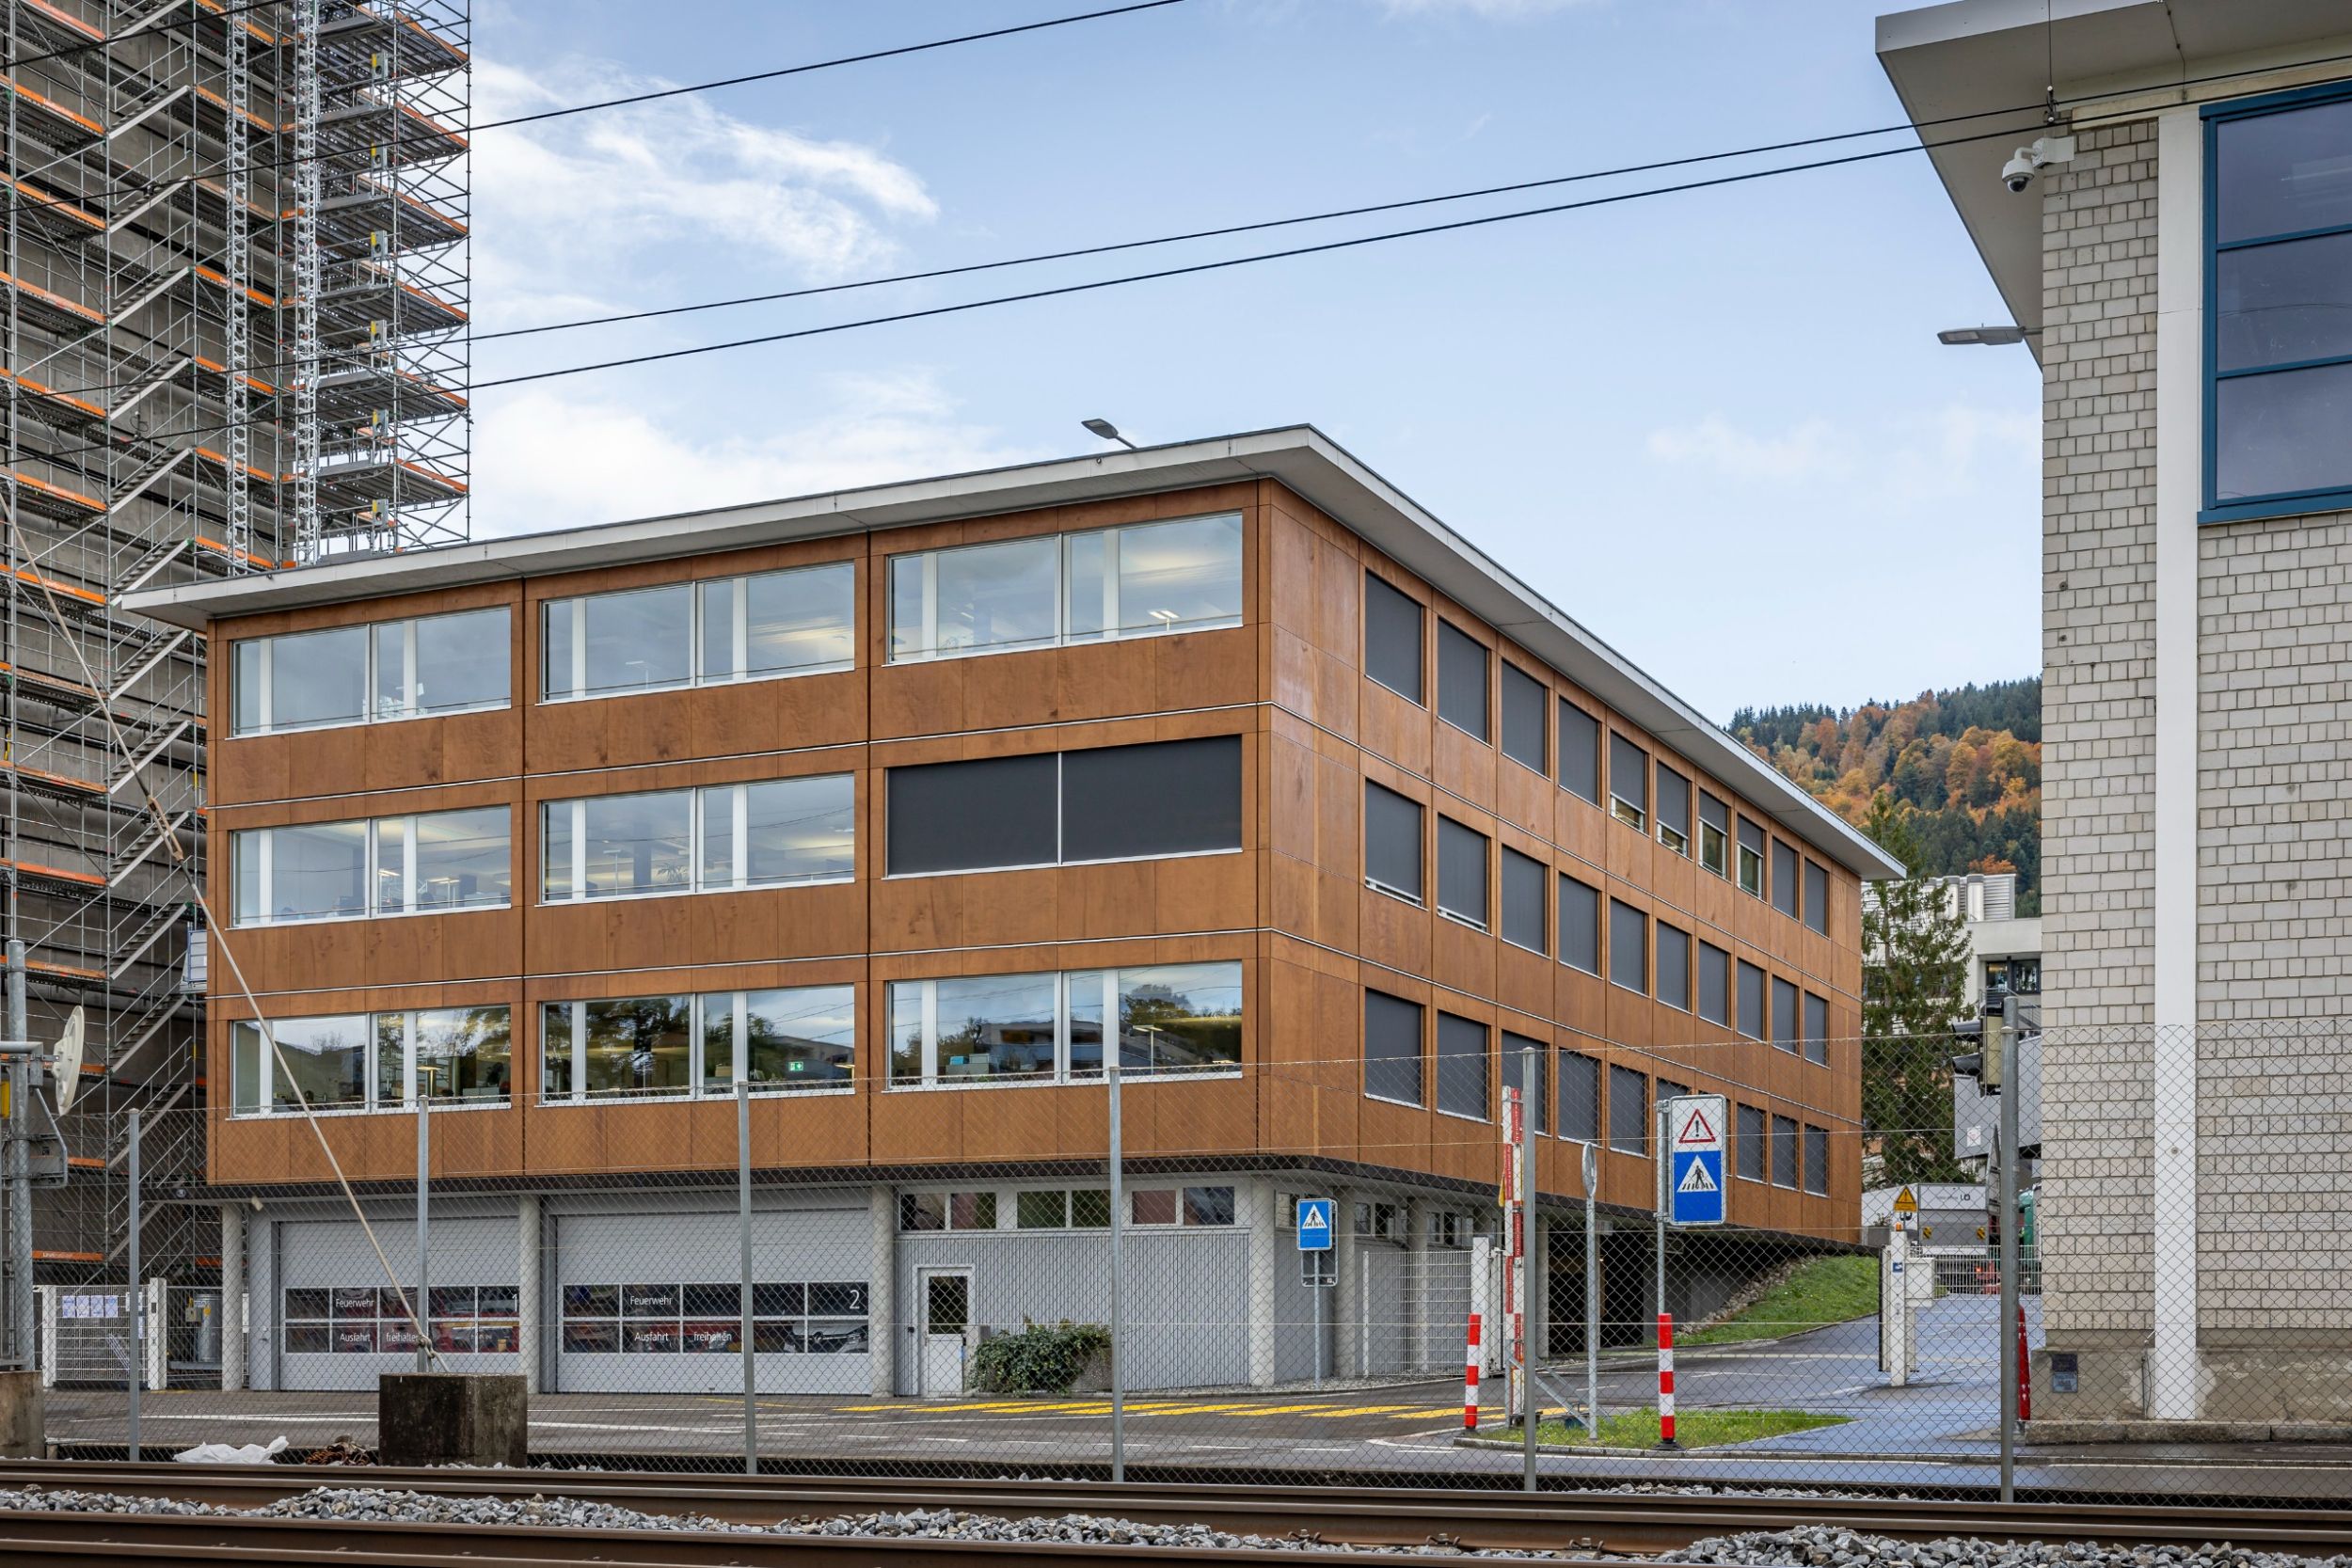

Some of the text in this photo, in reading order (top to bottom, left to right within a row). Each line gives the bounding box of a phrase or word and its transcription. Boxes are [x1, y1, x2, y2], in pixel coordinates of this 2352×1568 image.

[335, 1298, 374, 1308] Feuerwehr
[511, 1293, 517, 1312] 1
[629, 1295, 673, 1306] Feuerwehr
[849, 1289, 860, 1309] 2
[339, 1332, 371, 1342] Ausfahrt
[634, 1331, 732, 1341] Ausfahrt freihalten
